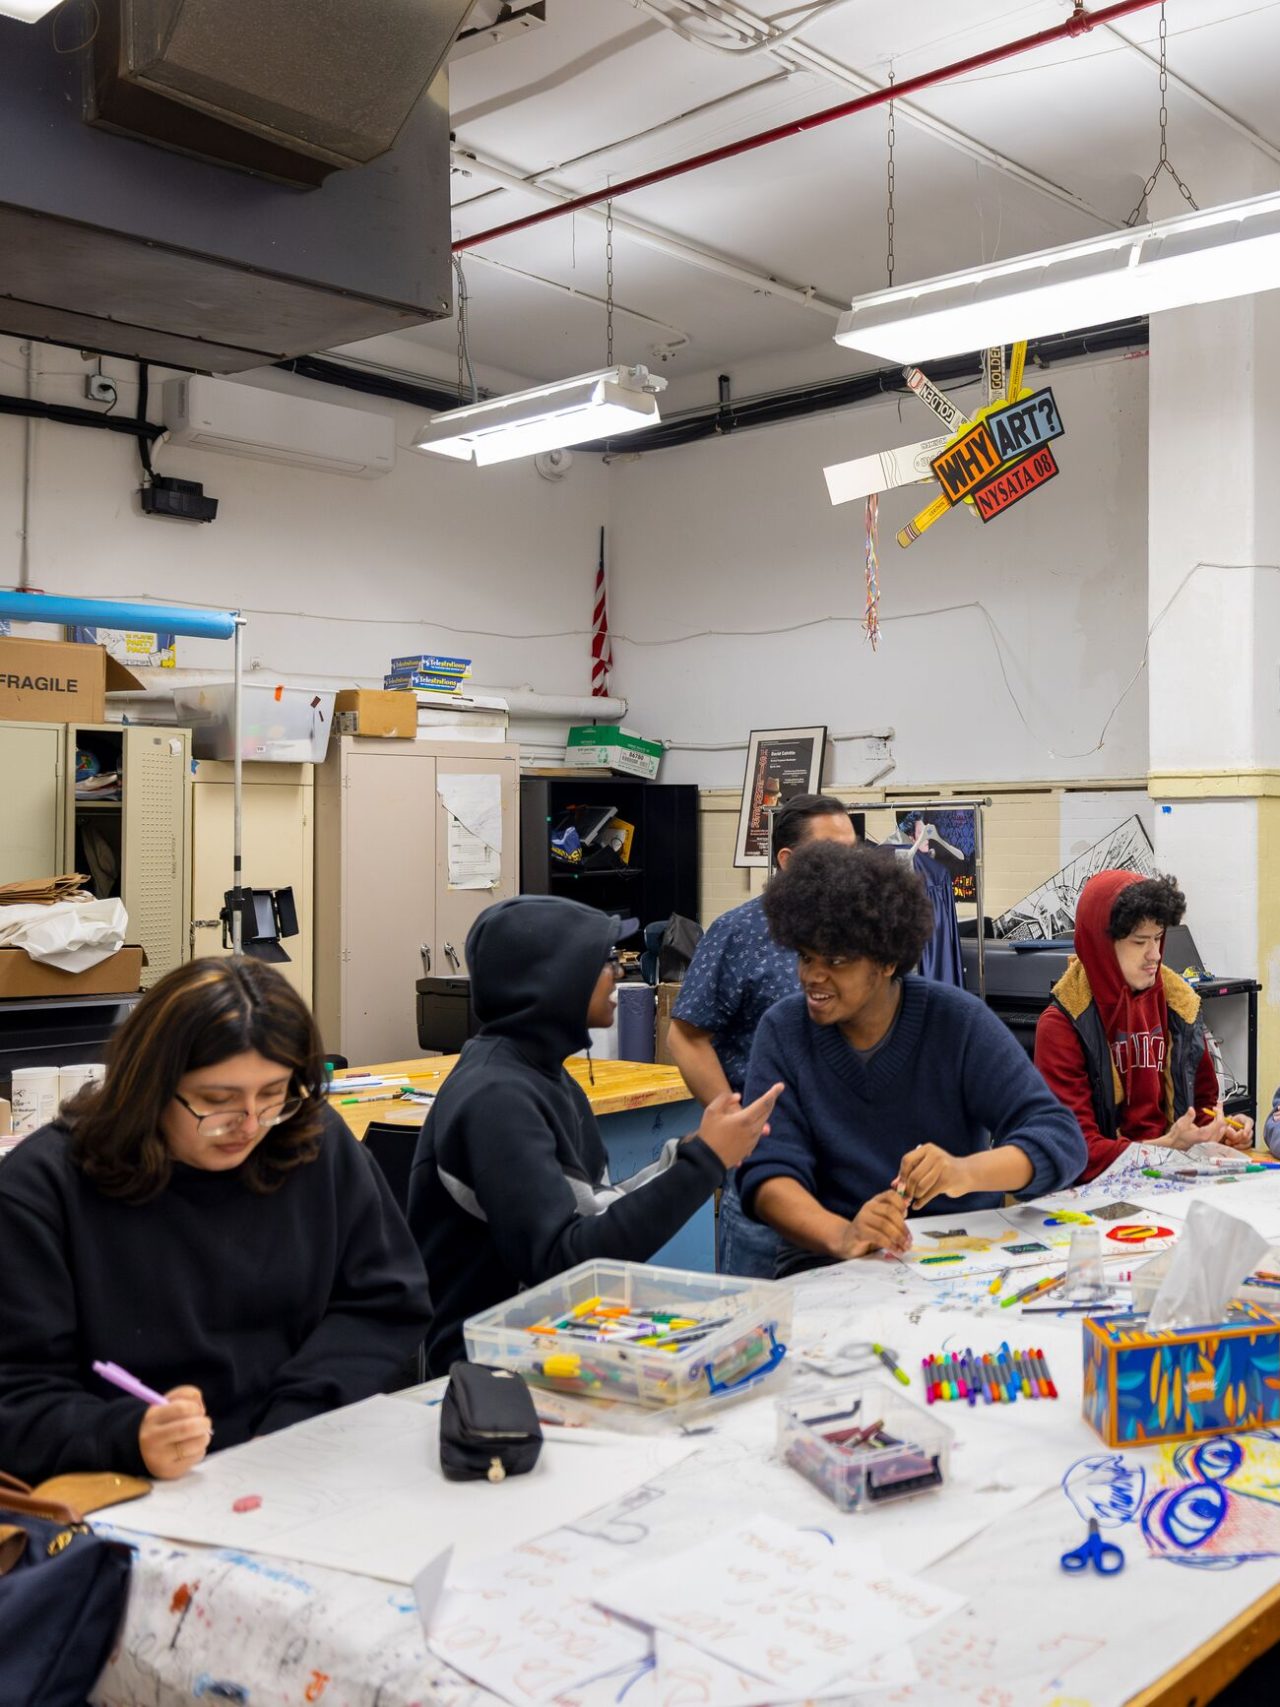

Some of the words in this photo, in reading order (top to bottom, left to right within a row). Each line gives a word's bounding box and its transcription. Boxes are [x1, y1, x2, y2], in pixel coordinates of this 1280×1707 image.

[920, 384, 956, 423] GOLDEN
[938, 431, 995, 496] WHY
[995, 398, 1054, 457] ART?
[978, 468, 1034, 515] NYSATA
[1032, 456, 1052, 479] 08
[419, 677, 457, 686] Telestrations
[430, 660, 465, 669] Telestrations
